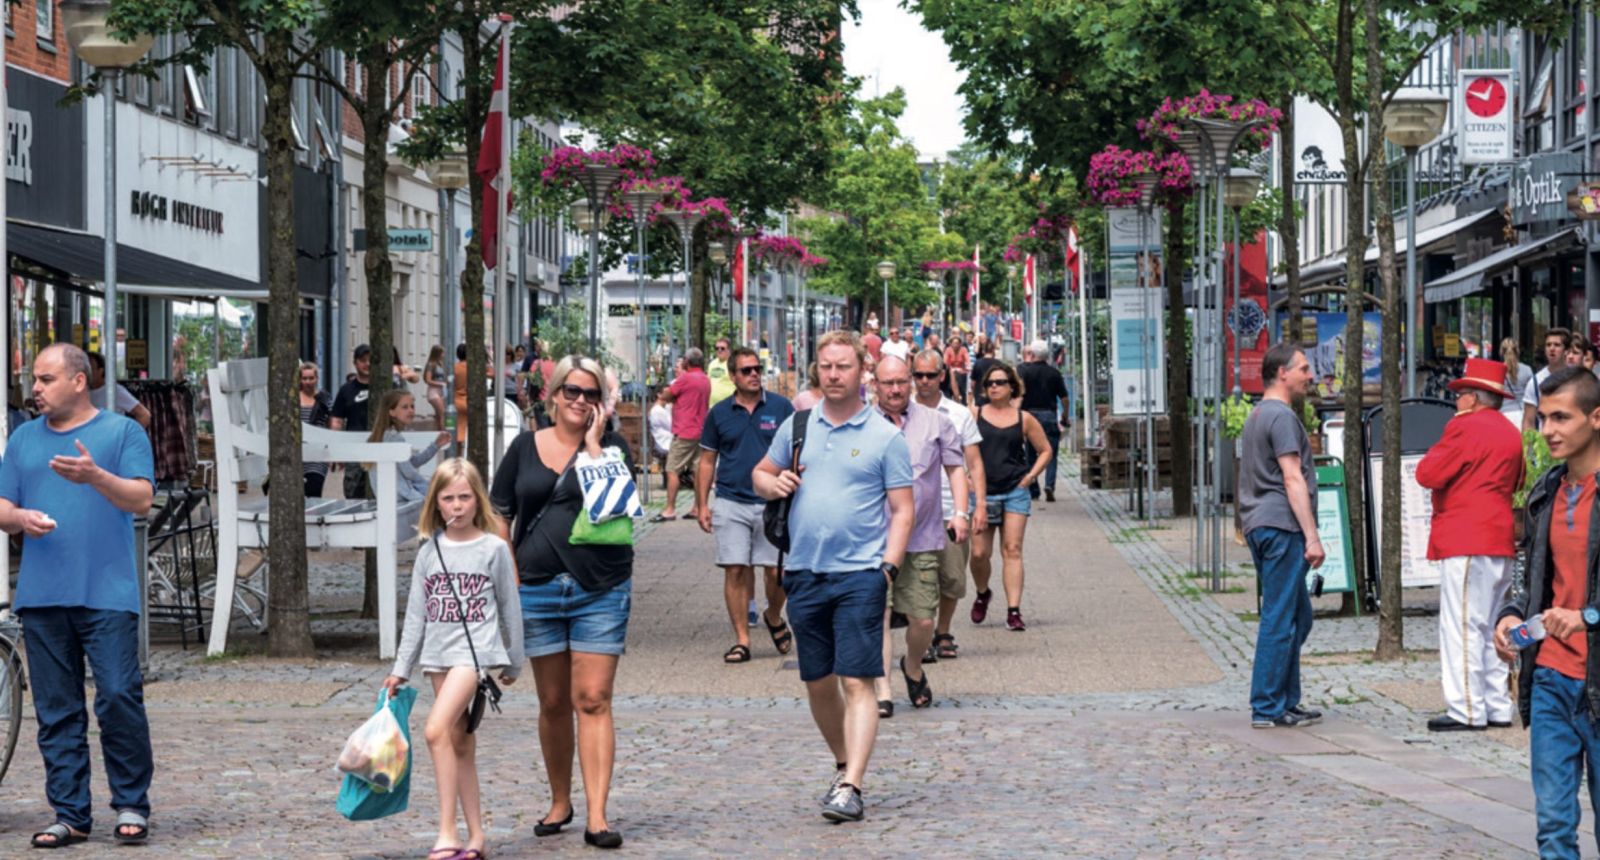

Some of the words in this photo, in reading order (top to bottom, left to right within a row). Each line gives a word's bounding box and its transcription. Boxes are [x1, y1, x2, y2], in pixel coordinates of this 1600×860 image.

[1464, 123, 1506, 132] CITIZEN
[1524, 171, 1562, 215] Optik
[388, 233, 428, 246] otek
[424, 572, 490, 599] NEW
[426, 597, 487, 622] ORK
